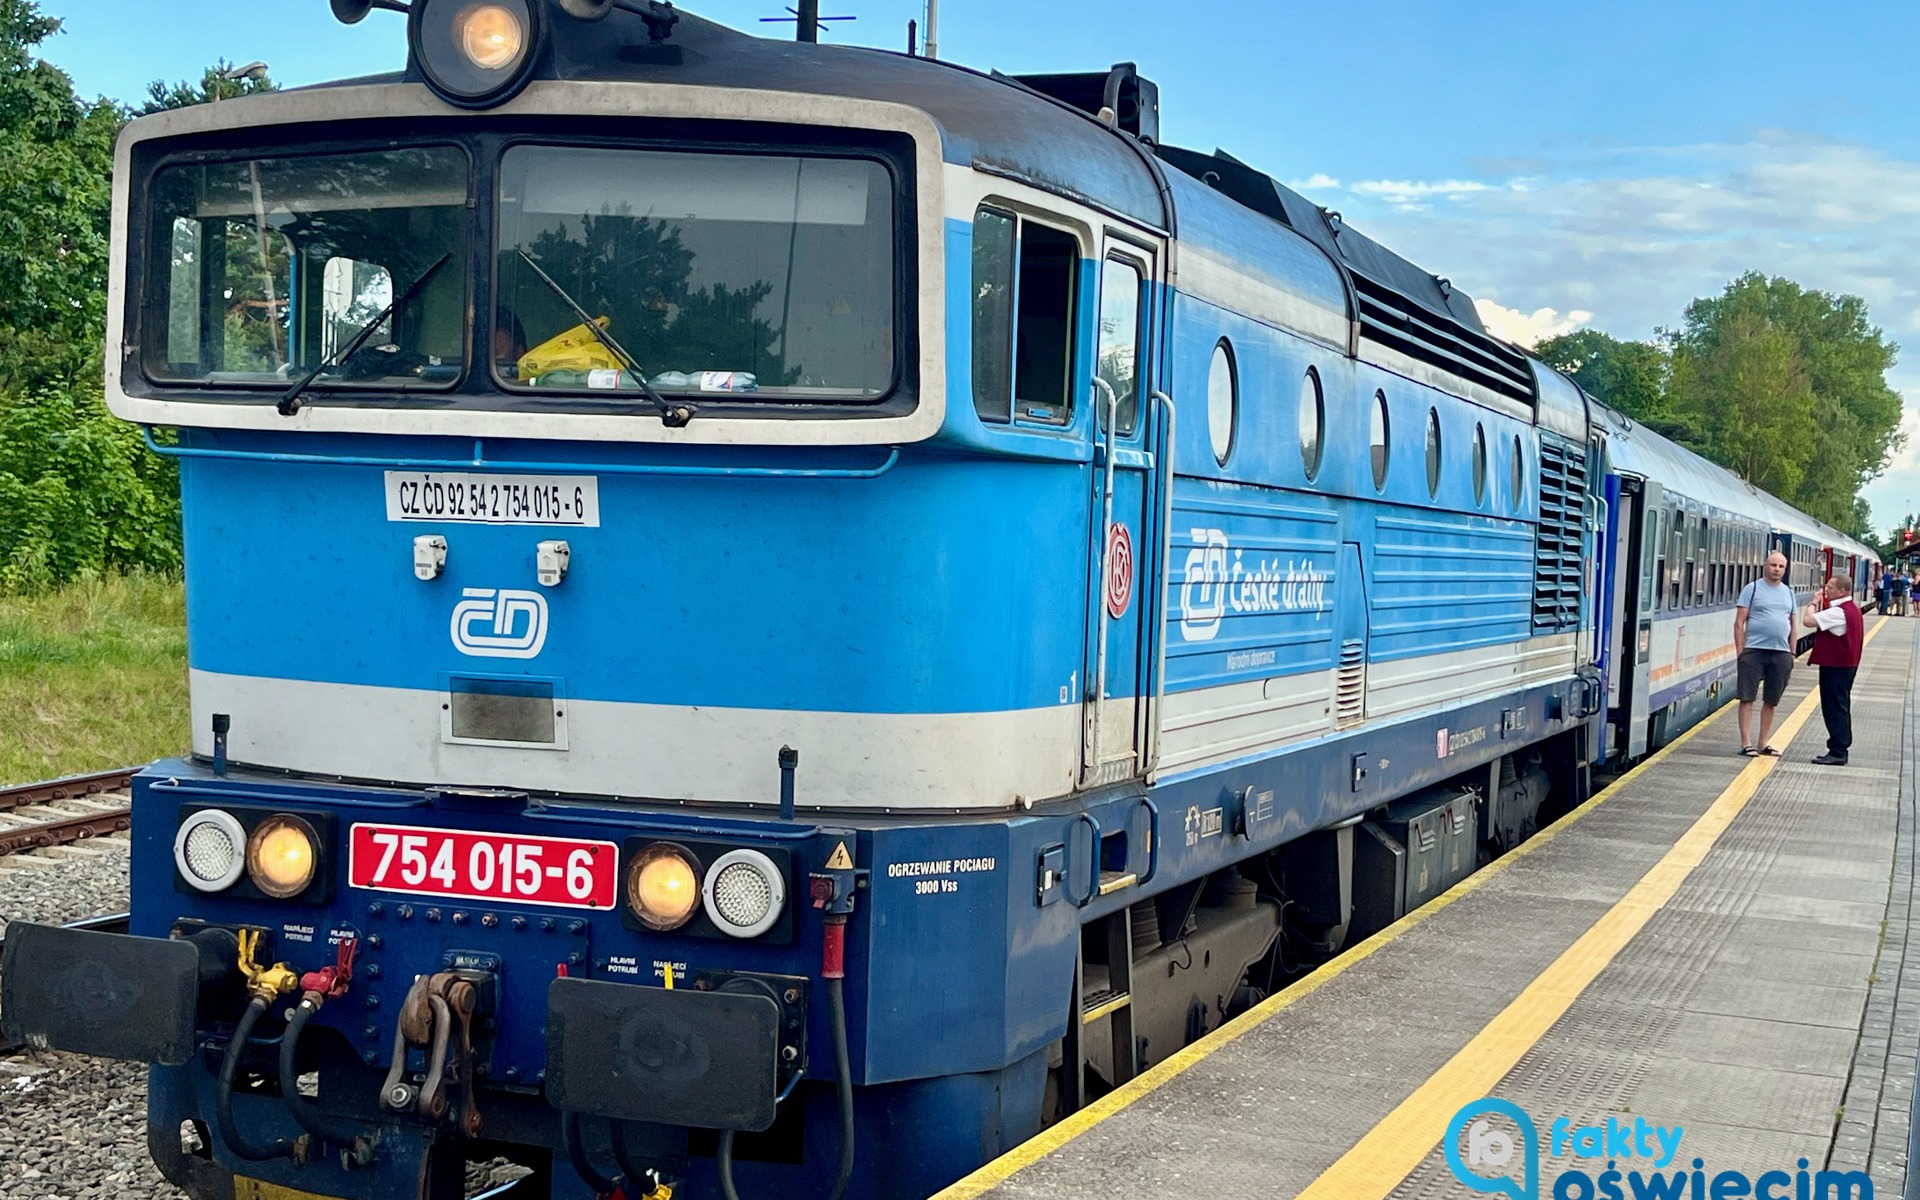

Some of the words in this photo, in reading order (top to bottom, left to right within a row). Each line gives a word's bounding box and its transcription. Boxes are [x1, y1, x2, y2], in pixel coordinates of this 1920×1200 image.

[400, 481, 420, 514] CZ
[424, 474, 444, 515] ČD
[448, 482, 465, 516] 92
[470, 483, 487, 517] 54
[491, 484, 499, 517] 2
[503, 484, 530, 518] 754
[1230, 548, 1281, 612] České
[1282, 557, 1327, 621] dráhy
[450, 587, 549, 660] ČD
[1070, 669, 1077, 703] 1
[372, 833, 456, 889] 754
[469, 841, 594, 900] 015-6
[888, 860, 952, 877] OGRZEWANIE
[915, 880, 939, 895] 3000
[941, 879, 958, 893] Vss
